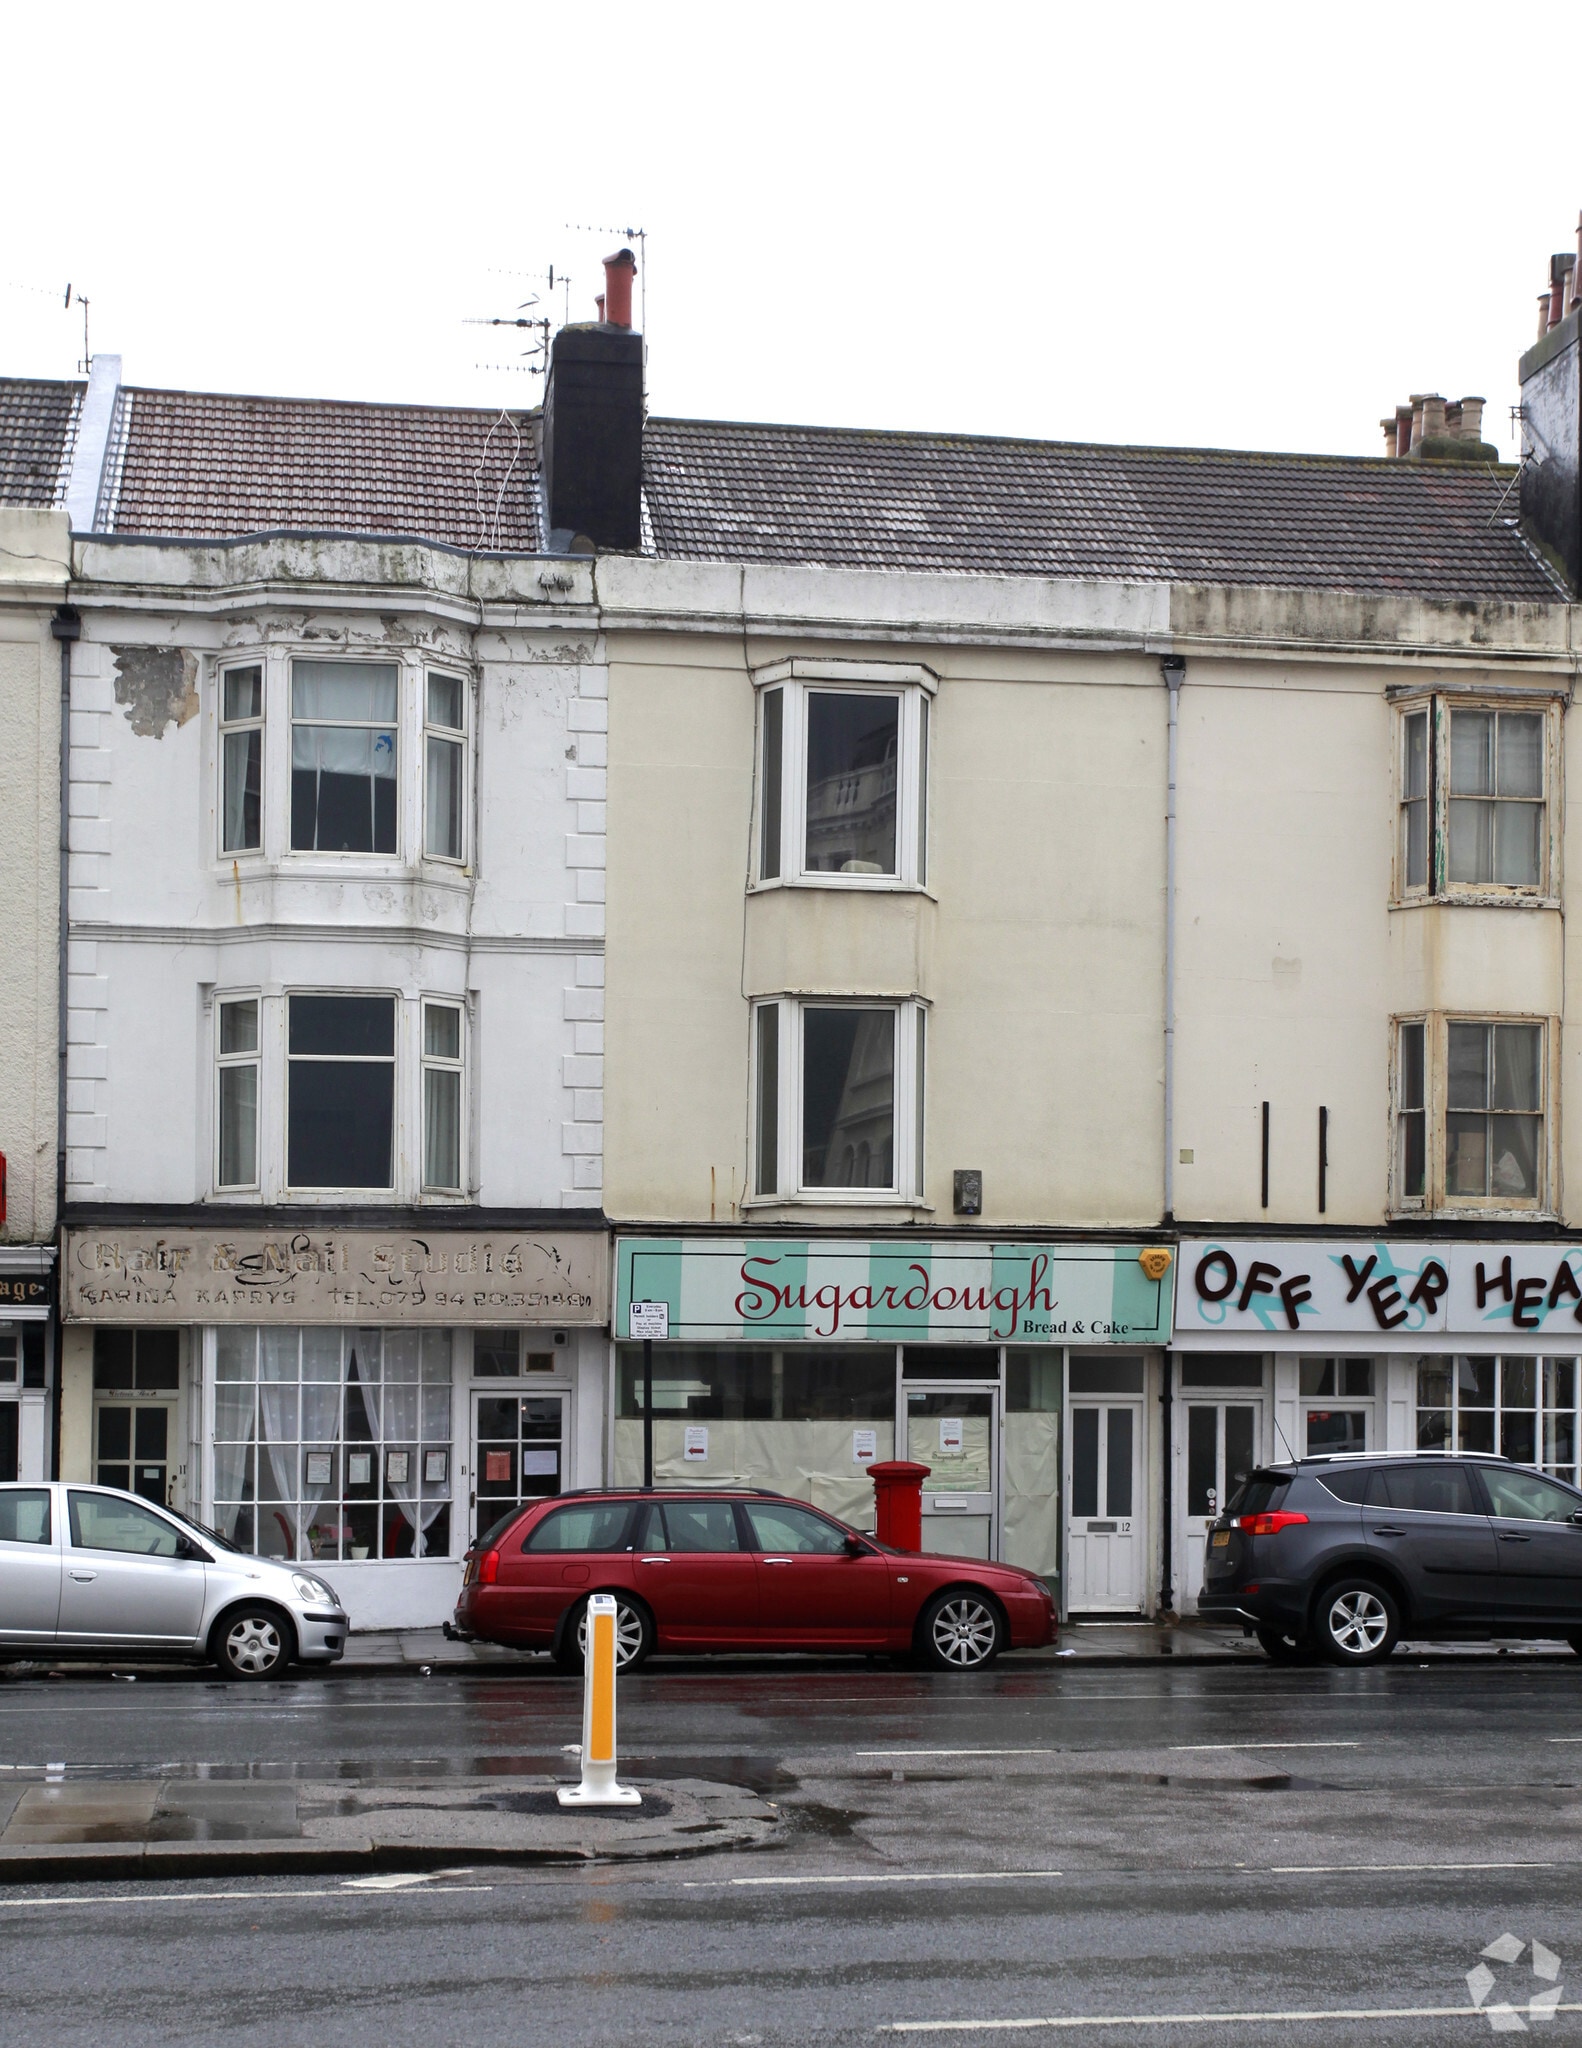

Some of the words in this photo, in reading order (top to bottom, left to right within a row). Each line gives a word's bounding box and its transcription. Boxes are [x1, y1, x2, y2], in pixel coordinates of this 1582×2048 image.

[213, 1242, 241, 1272] &
[373, 1242, 523, 1273] Studio
[735, 1254, 1059, 1338] Sugardough
[1195, 1250, 1311, 1329] OFF
[1342, 1254, 1449, 1329] YER
[1476, 1256, 1582, 1327] HEA
[1023, 1320, 1067, 1334] Bread
[1071, 1320, 1085, 1334] &
[1090, 1320, 1129, 1335] Cake
[1121, 1522, 1131, 1532] 12
